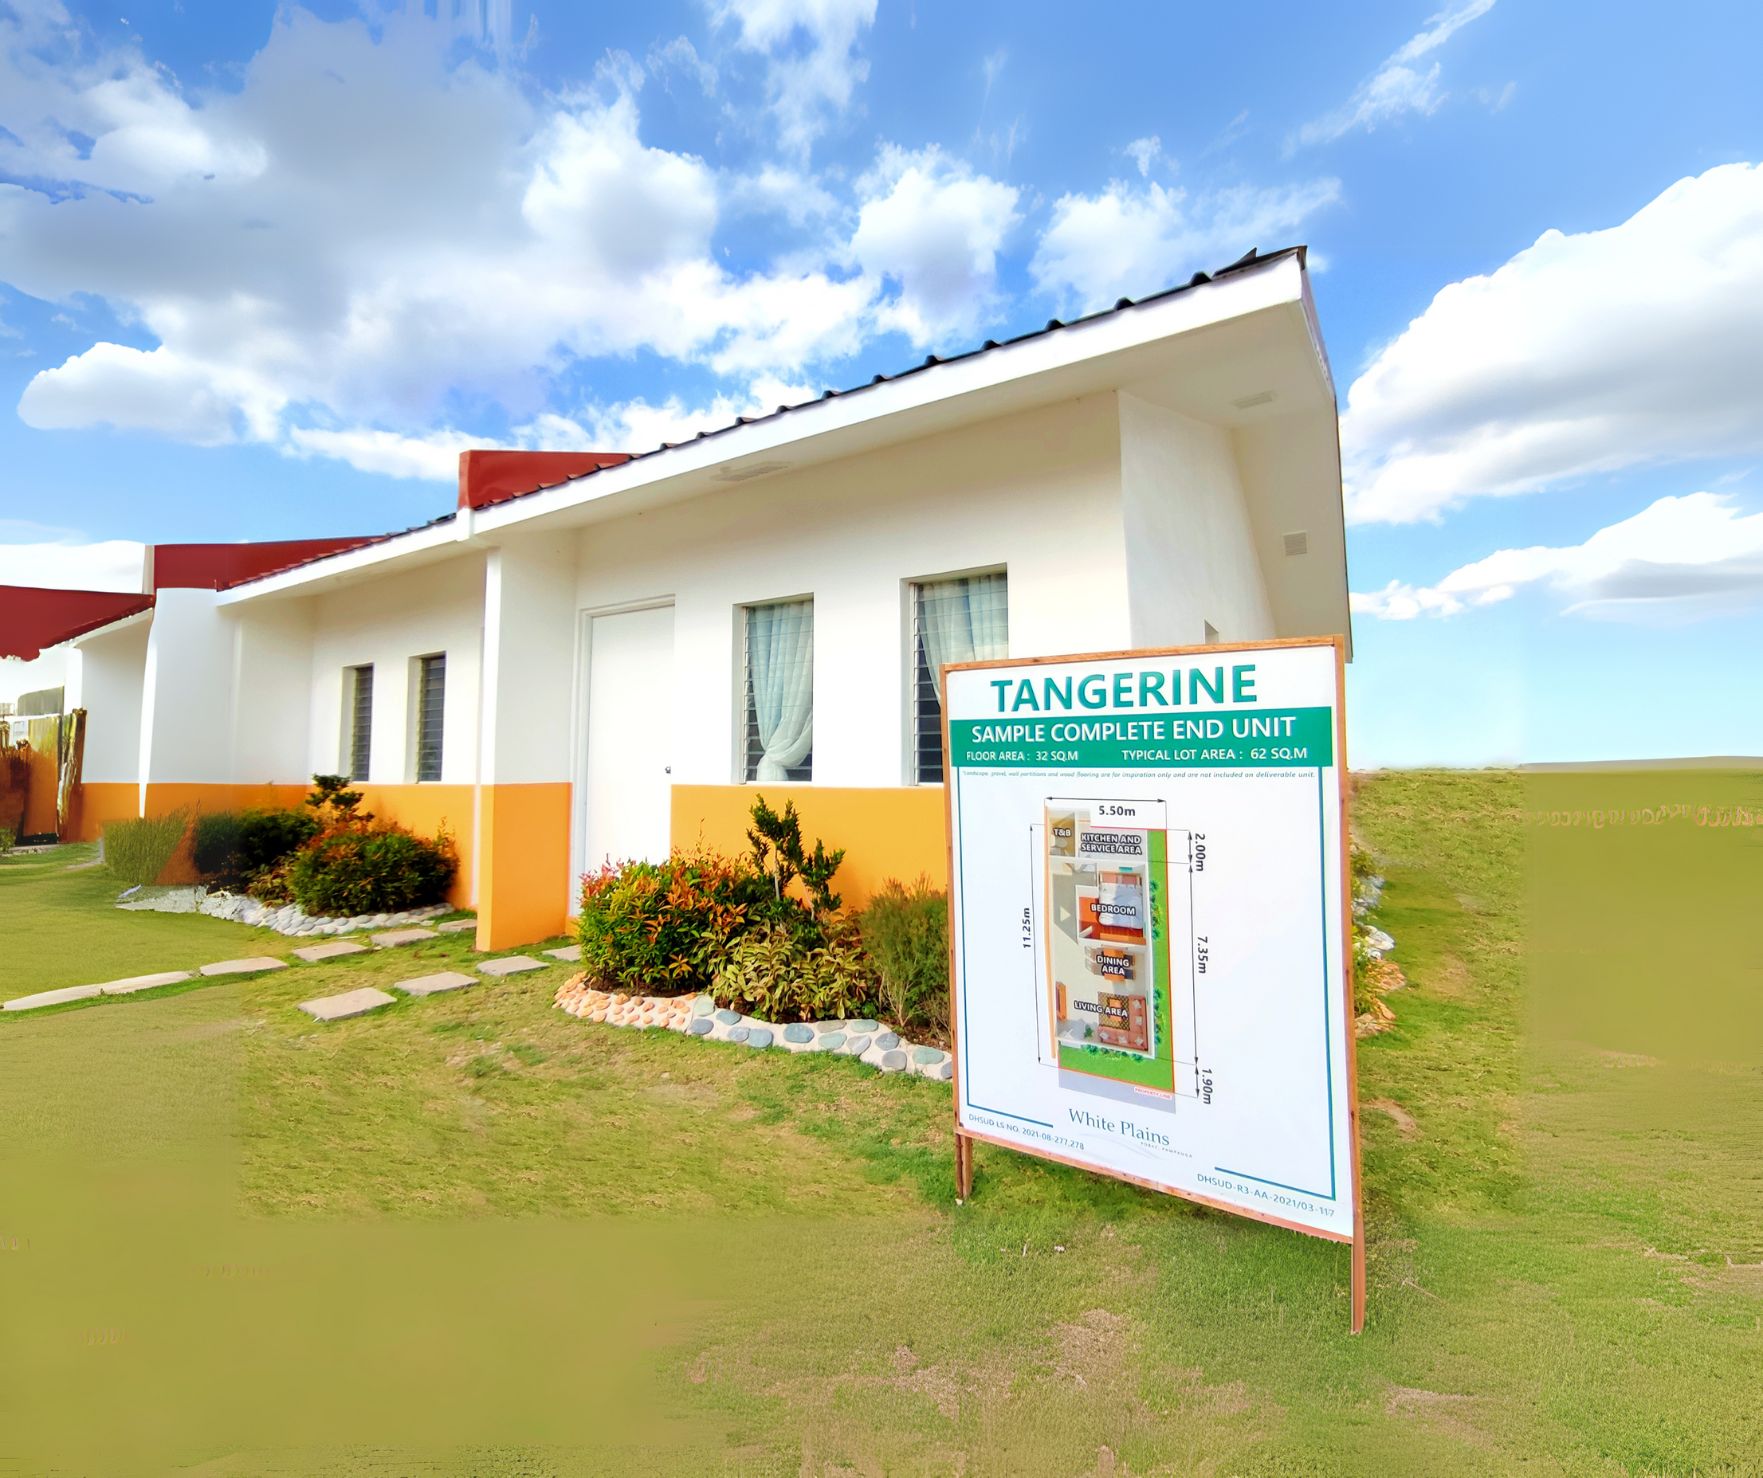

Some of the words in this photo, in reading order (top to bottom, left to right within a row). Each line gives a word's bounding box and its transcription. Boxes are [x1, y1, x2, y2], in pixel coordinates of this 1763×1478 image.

[990, 664, 1257, 712] TANGERINE
[971, 723, 1045, 743] SAMPLE
[1050, 720, 1165, 742] COMPLETE
[1173, 718, 1224, 739] END
[1232, 716, 1296, 738] UNIT
[966, 751, 996, 761] FLOOR
[998, 751, 1024, 761] AREA
[1036, 751, 1048, 761] 32
[1050, 750, 1078, 762] SQ.M
[1121, 749, 1170, 762] TYPICAL
[1174, 749, 1197, 761] LOT
[1200, 749, 1236, 760] AREA
[1250, 748, 1267, 760] 62
[1271, 747, 1308, 761] SQ.M
[1098, 805, 1136, 817] 5.50m
[1053, 828, 1072, 837] T&B
[1081, 833, 1118, 843] KITCHEN
[1120, 834, 1141, 844] AND
[1081, 844, 1116, 853] SERVICE
[1117, 845, 1142, 854] AREA
[1195, 833, 1206, 872] 2.00m
[1091, 903, 1136, 916] BEDROOM
[1022, 907, 1031, 949] 11.25m
[1097, 954, 1130, 968] DINING
[1197, 936, 1209, 974] 7.35m
[1102, 966, 1125, 976] AREA
[1074, 1000, 1103, 1013] LIVING
[1105, 1006, 1128, 1018] AREA
[1202, 1068, 1214, 1105] 1.90m
[968, 1113, 995, 1126] DHSUD
[1068, 1108, 1115, 1133] White
[1120, 1120, 1170, 1146] Plains
